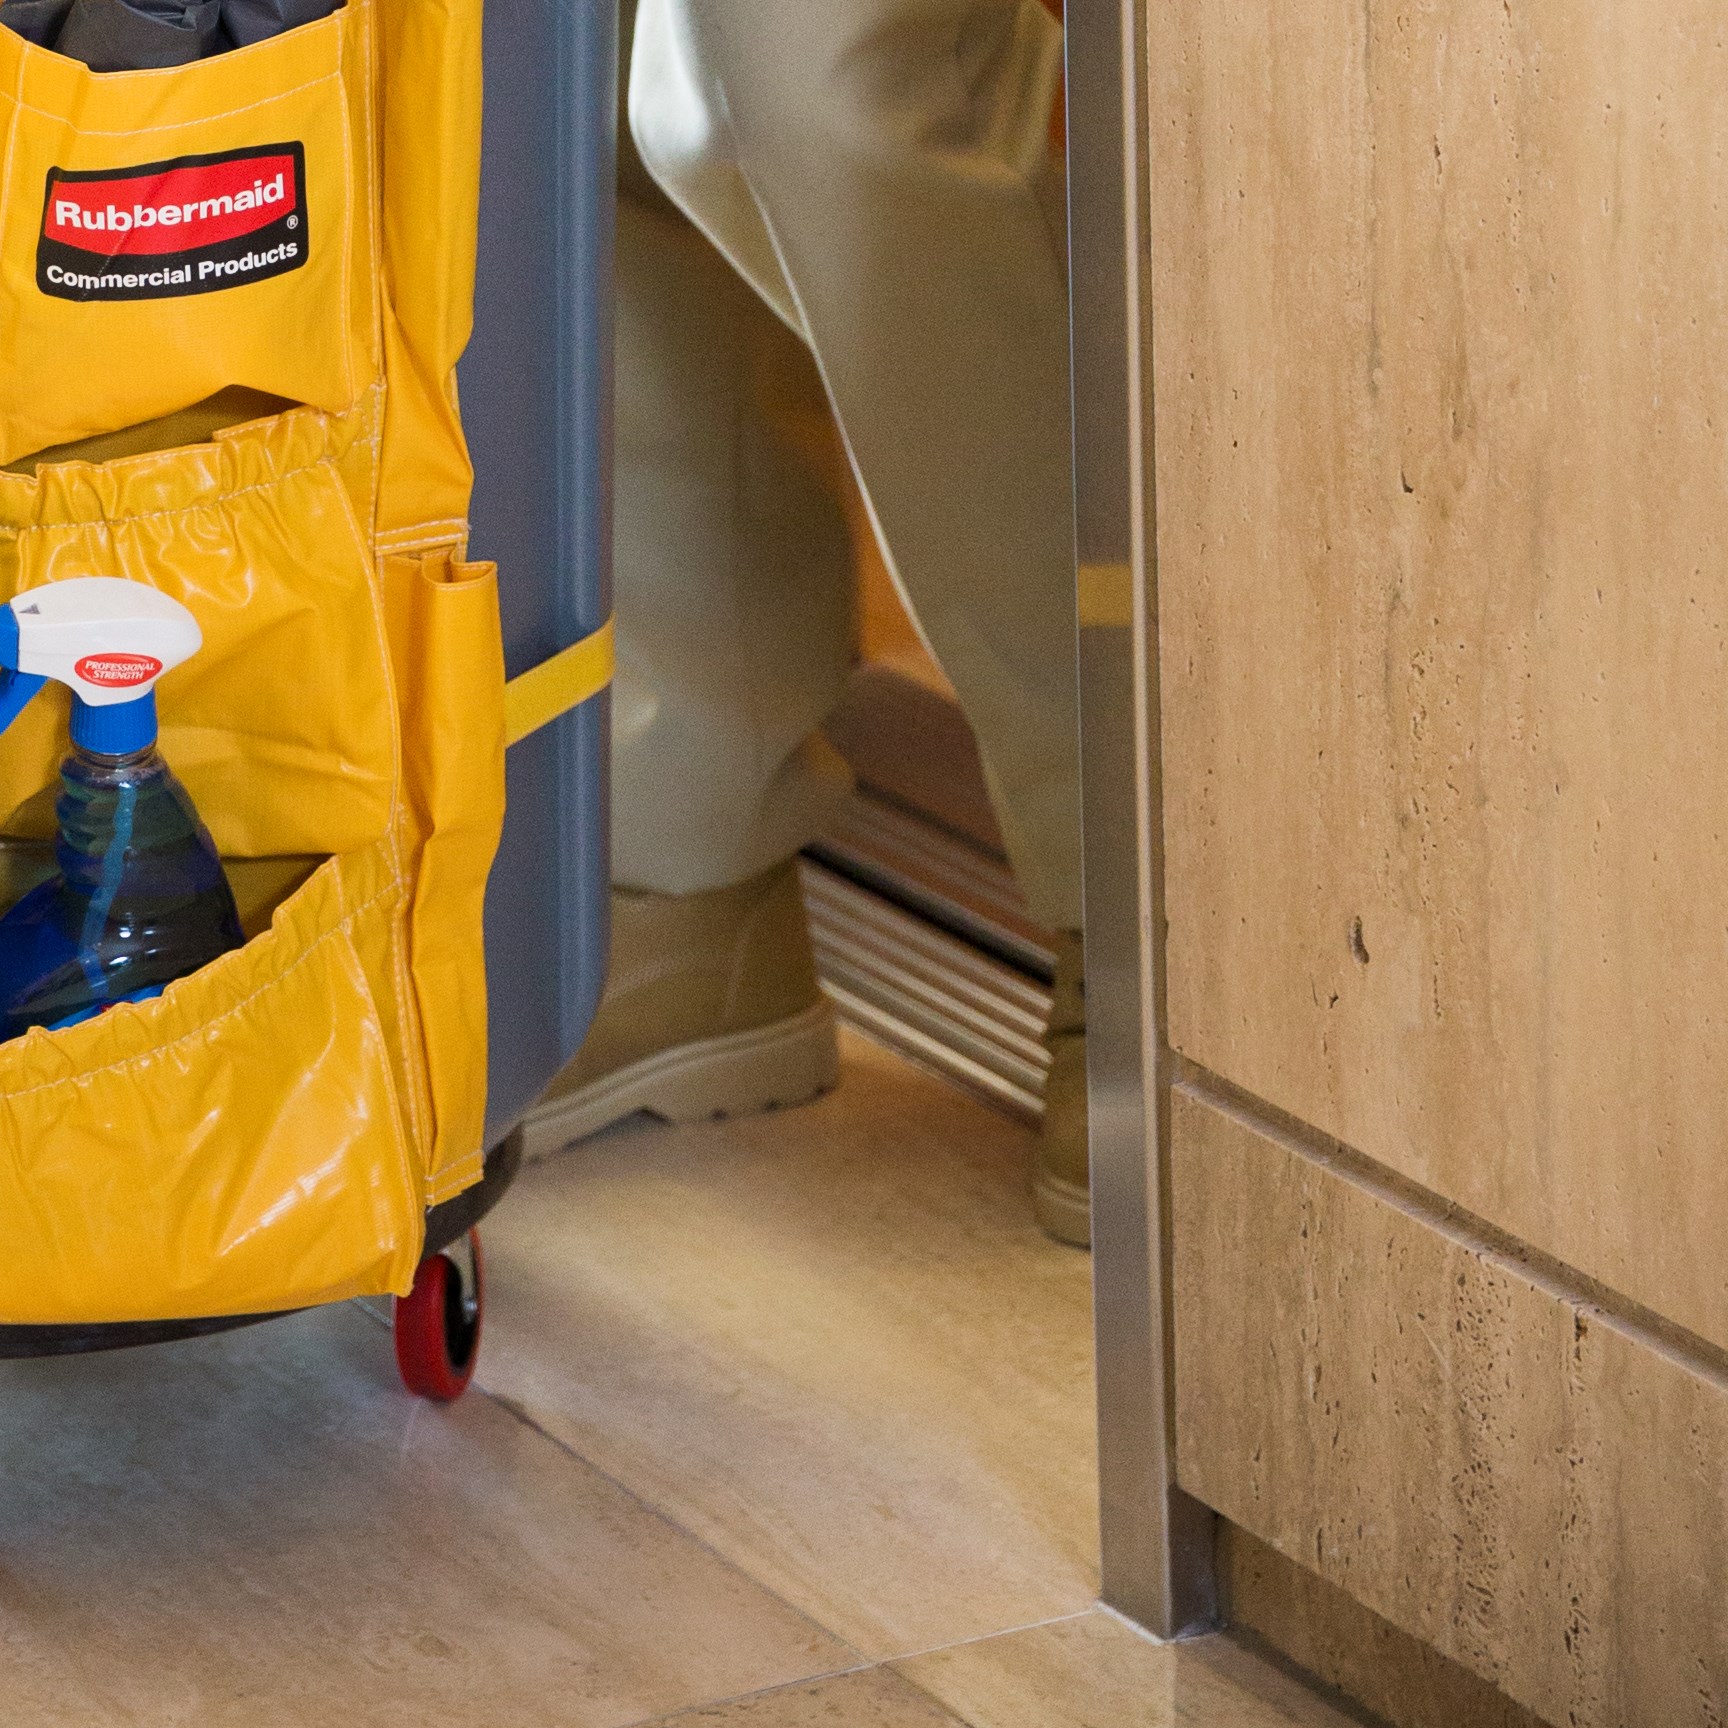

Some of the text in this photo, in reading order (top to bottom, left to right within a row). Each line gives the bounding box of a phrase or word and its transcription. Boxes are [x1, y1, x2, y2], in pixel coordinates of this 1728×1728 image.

[55, 172, 285, 232] Rubbermaid
[46, 241, 299, 290] Commercial Products
[85, 660, 155, 670] PROFESSIONAL
[93, 671, 144, 679] STRENGTH
